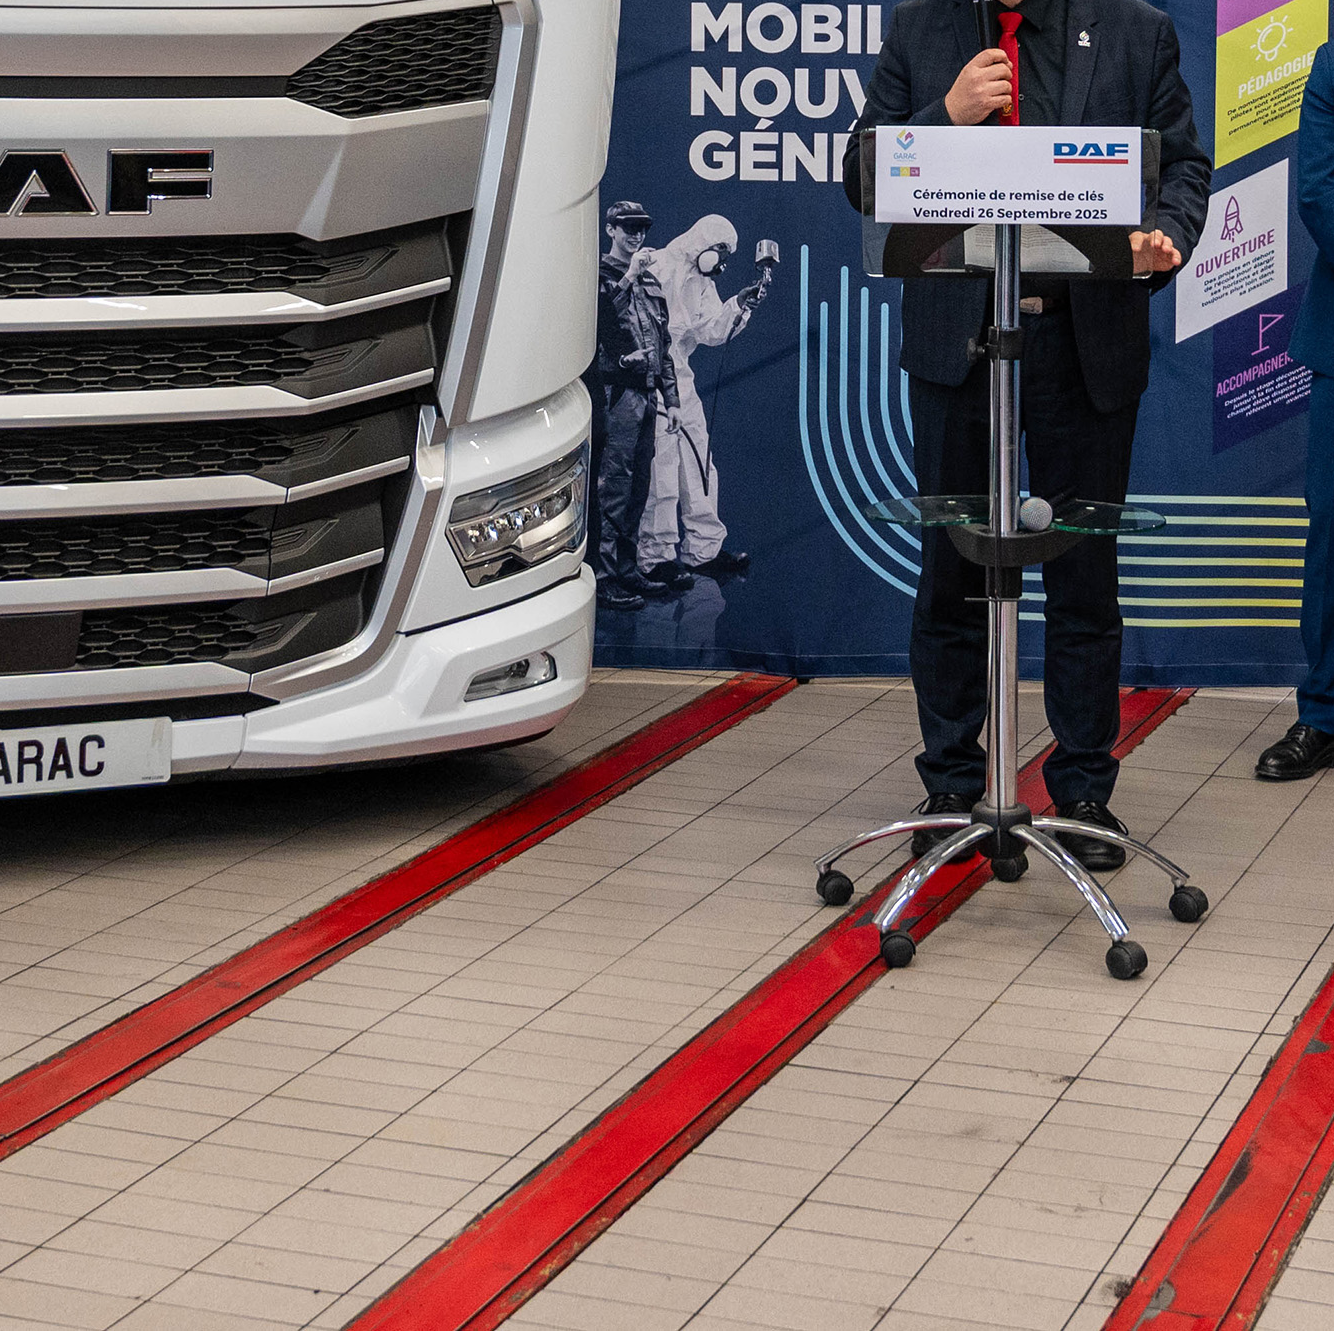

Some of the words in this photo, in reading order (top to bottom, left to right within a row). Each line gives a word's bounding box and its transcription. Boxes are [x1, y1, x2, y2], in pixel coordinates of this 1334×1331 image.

[691, 2, 883, 54] MOBIL
[893, 152, 917, 160] GARAC
[1053, 142, 1129, 157] DAF
[913, 189, 986, 201] Cérémonie
[990, 189, 1006, 201] de
[1009, 190, 1055, 202] remise
[1058, 190, 1075, 202] de
[1078, 189, 1104, 202] clés
[913, 207, 974, 219] Vendredi
[978, 208, 994, 219] 26
[997, 208, 1072, 221] Septembre
[1075, 209, 1108, 220] 2025
[1195, 228, 1275, 278] OUVERTURE
[1204, 278, 1216, 286] Des
[1218, 266, 1240, 280] projets
[1252, 250, 1274, 263] dehors
[1236, 267, 1252, 278] pour
[1201, 292, 1228, 307] toujours
[1230, 285, 1244, 295] plus
[1259, 270, 1274, 280] dans
[1223, 276, 1250, 290] horizons
[1216, 351, 1293, 397] ACCOMPAGNE
